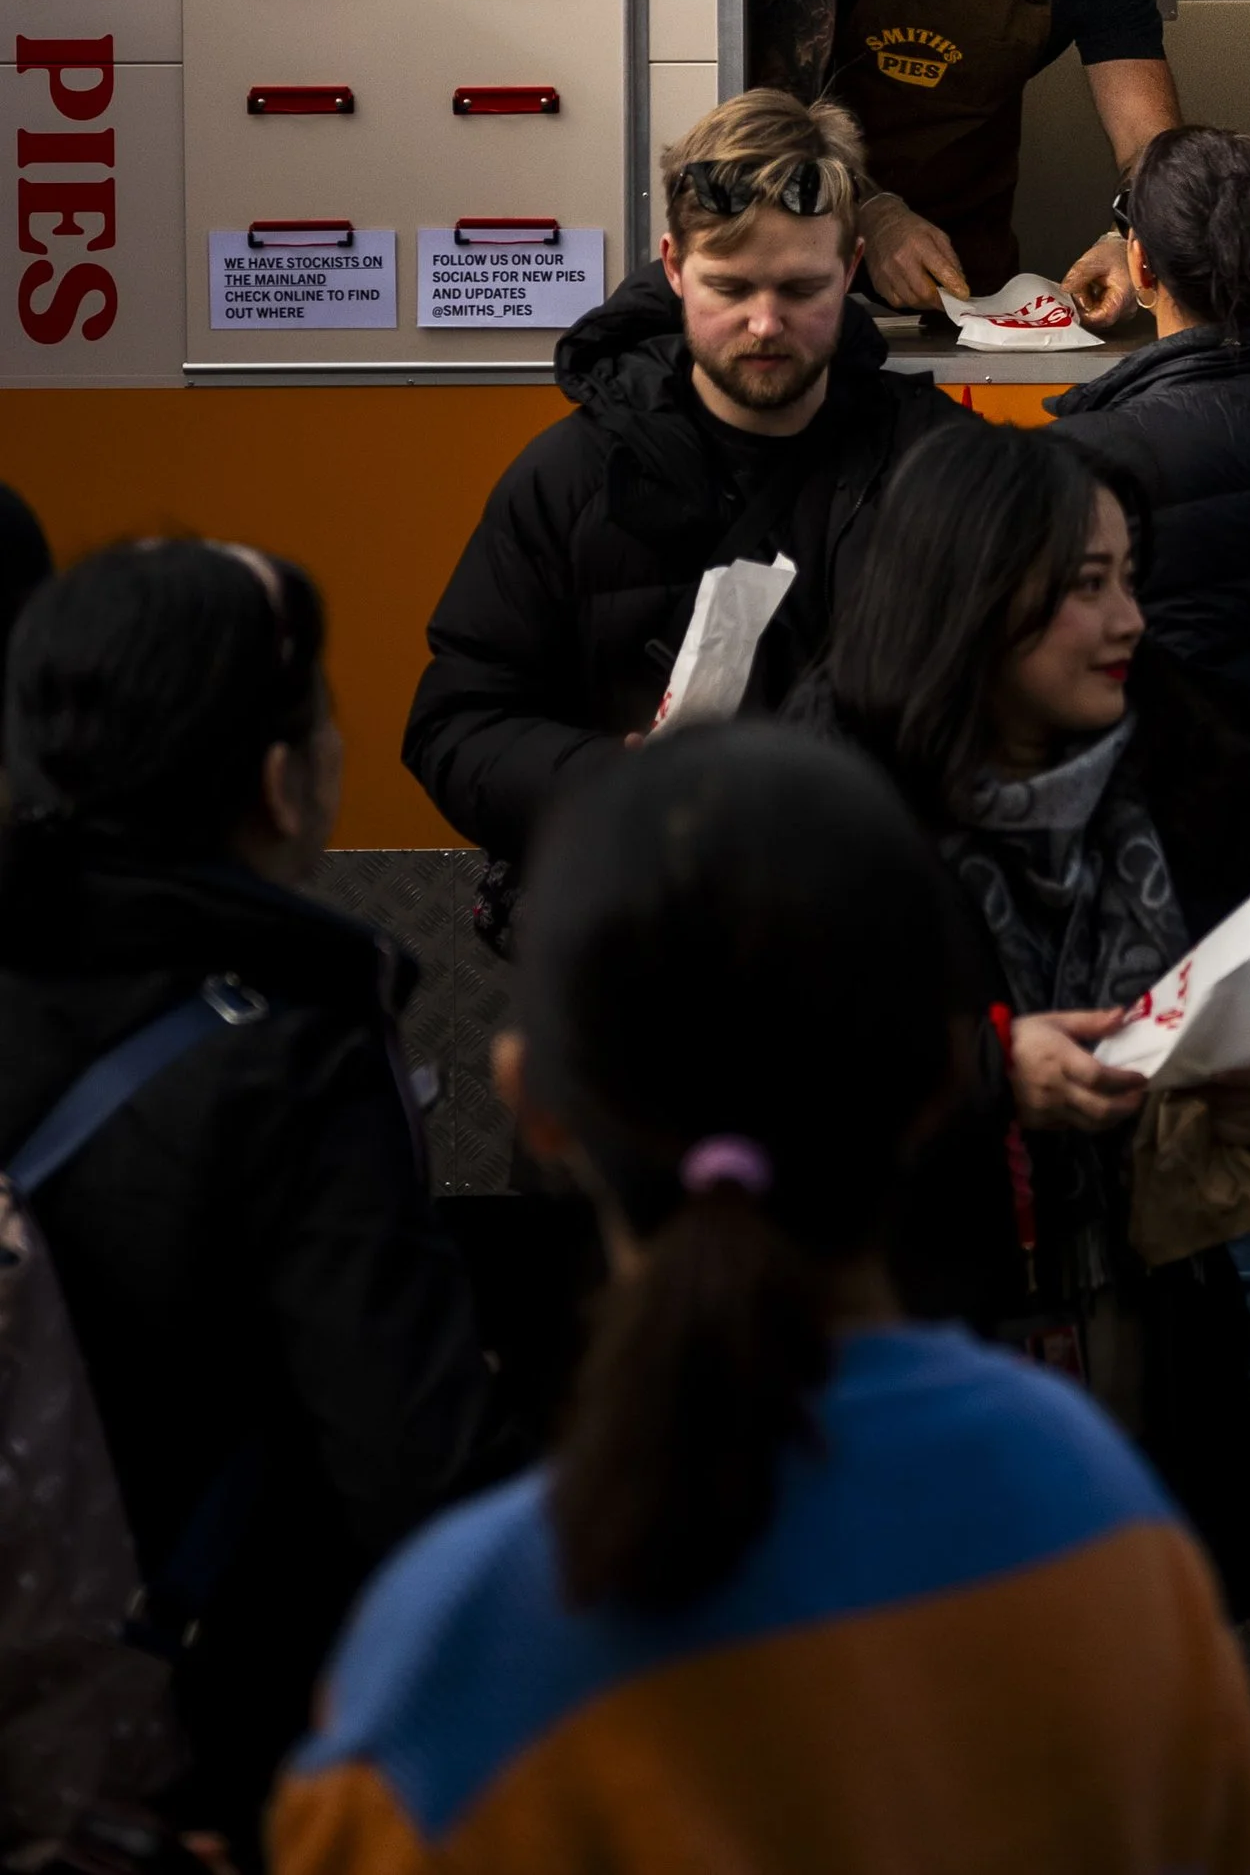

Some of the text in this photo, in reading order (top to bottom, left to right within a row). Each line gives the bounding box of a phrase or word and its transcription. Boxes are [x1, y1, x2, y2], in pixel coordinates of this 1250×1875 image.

[866, 27, 962, 64] SMITH'S
[883, 57, 940, 78] PIES
[16, 34, 119, 344] PIES
[224, 256, 382, 268] WE HAVE STOCKISTS ON
[433, 254, 563, 266] FOLLOW US ON OUR
[225, 274, 326, 285] THE MAINLAND
[433, 271, 585, 282] SOCIALS FOR NEW PIES
[225, 290, 380, 302] CHECK ONLINE TO FIND
[433, 288, 526, 299] AND UPDATES
[226, 307, 304, 318] OUT WHERE
[433, 305, 532, 318] @SMITHS_PIES
